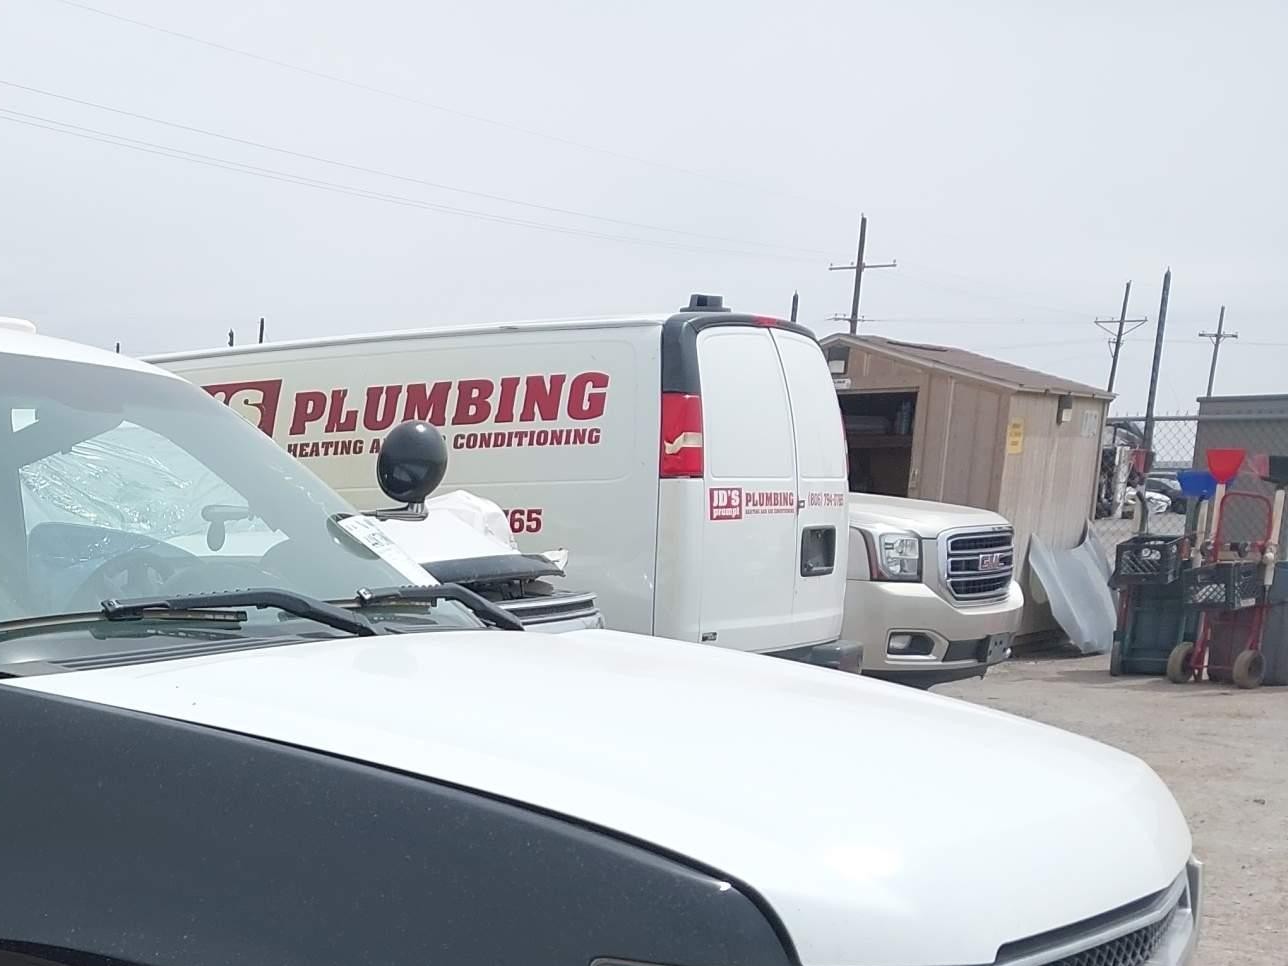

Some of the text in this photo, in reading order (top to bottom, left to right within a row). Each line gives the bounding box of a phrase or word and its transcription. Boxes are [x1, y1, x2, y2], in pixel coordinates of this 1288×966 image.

[289, 371, 610, 436] PLUMBING
[288, 439, 364, 458] HEATING
[452, 427, 601, 450] CONDITIONING
[712, 489, 740, 507] JD'S
[745, 491, 794, 507] PLUMBING
[503, 508, 543, 534] 65
